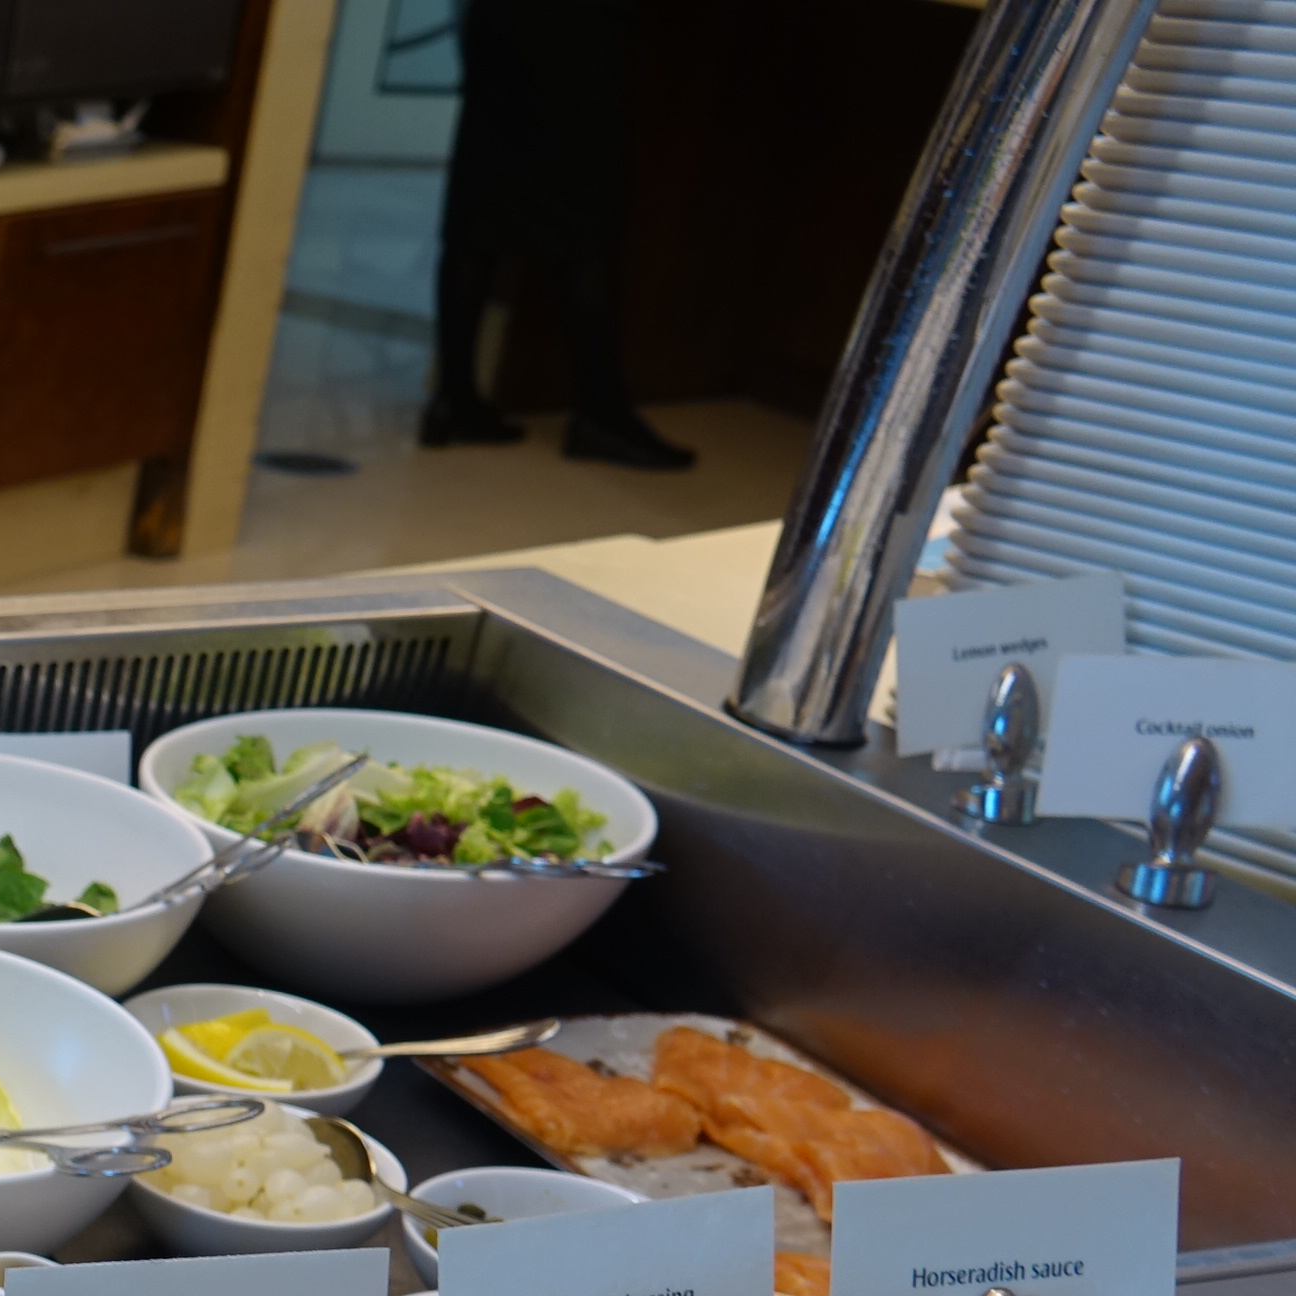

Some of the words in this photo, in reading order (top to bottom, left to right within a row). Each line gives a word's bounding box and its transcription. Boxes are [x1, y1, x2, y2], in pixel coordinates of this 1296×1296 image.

[1134, 717, 1203, 737] Cocktail
[1206, 723, 1255, 738] onion
[912, 1260, 1026, 1289] Horseradish
[1031, 1260, 1085, 1280] sauce
